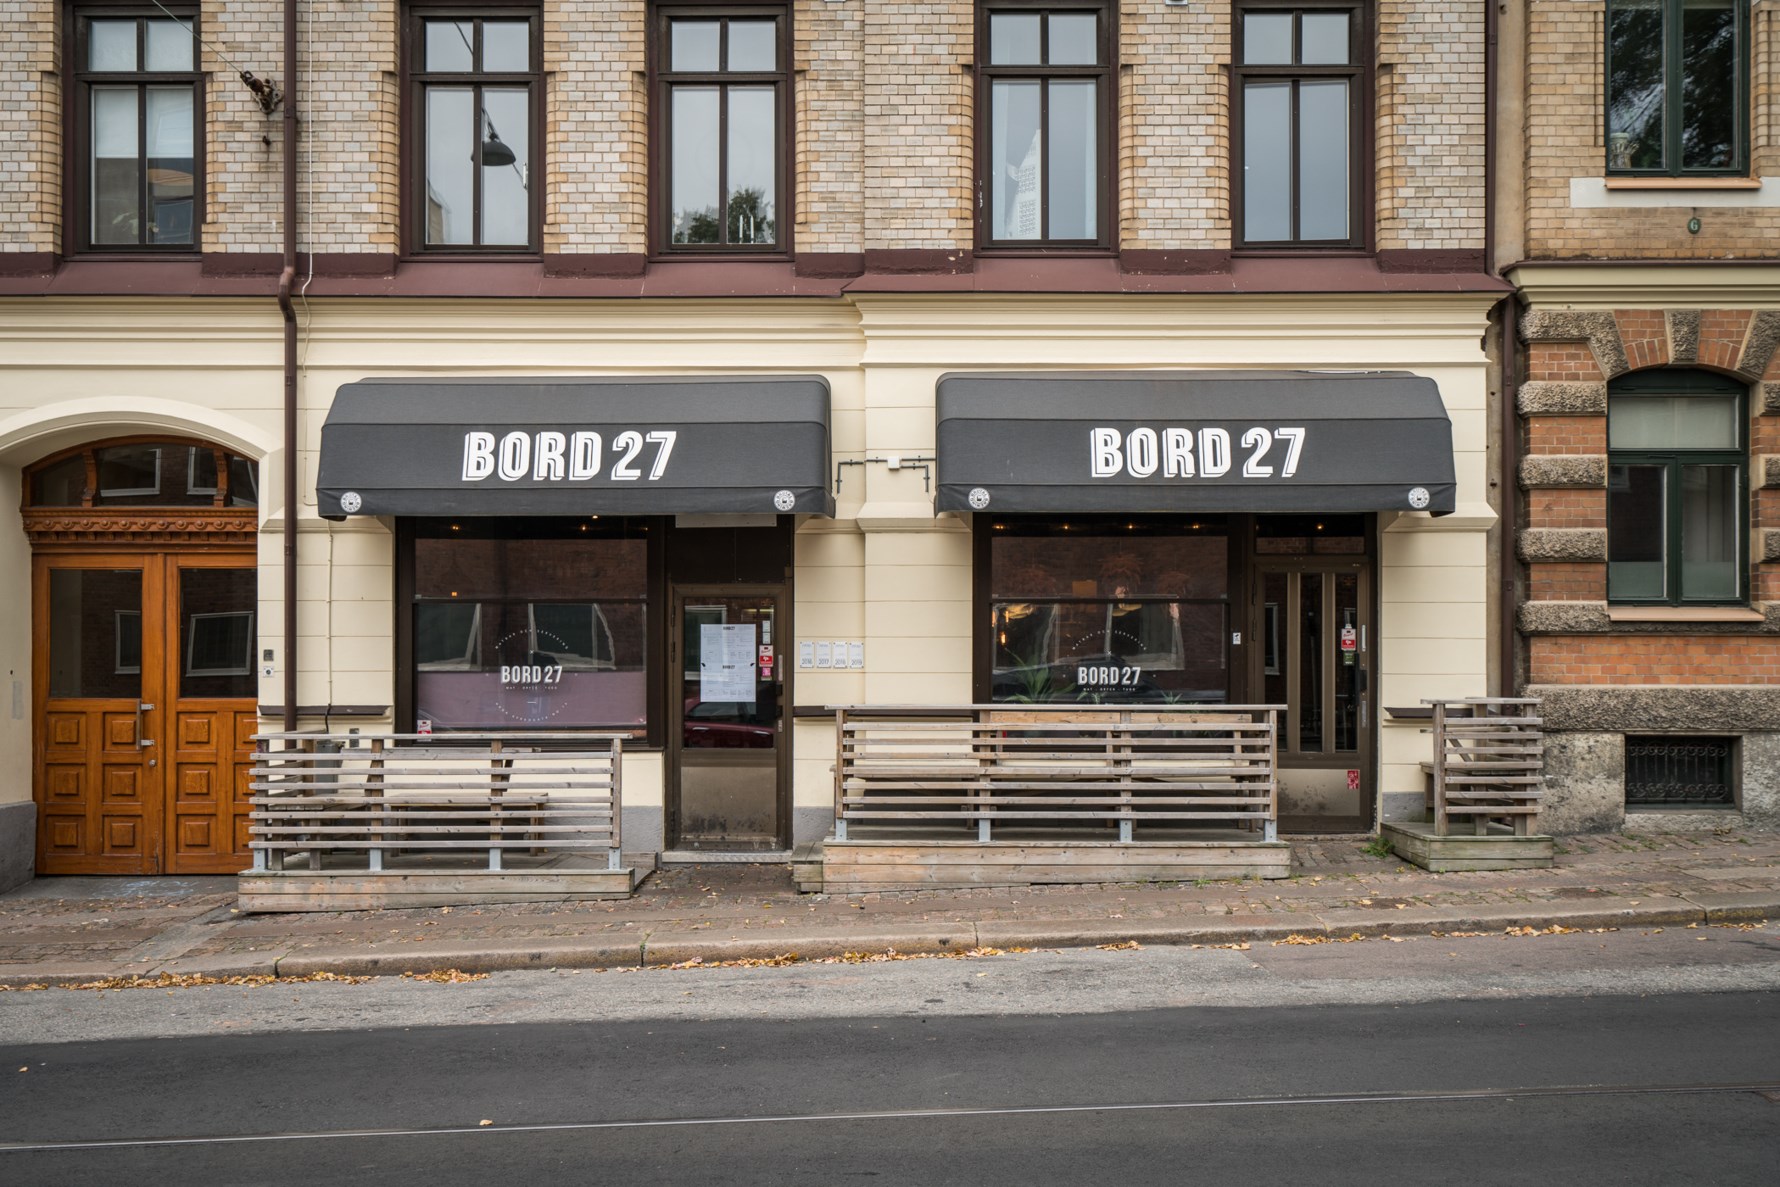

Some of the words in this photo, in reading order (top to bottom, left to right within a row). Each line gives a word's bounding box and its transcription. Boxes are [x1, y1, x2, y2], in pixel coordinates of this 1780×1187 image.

[462, 431, 602, 481] BORD
[611, 431, 677, 481] 27
[1090, 427, 1231, 478] BORD
[1241, 427, 1306, 478] 27
[501, 666, 541, 684] BORD
[544, 666, 563, 684] 27
[1078, 666, 1119, 685] BORD
[1121, 666, 1141, 685] 27
